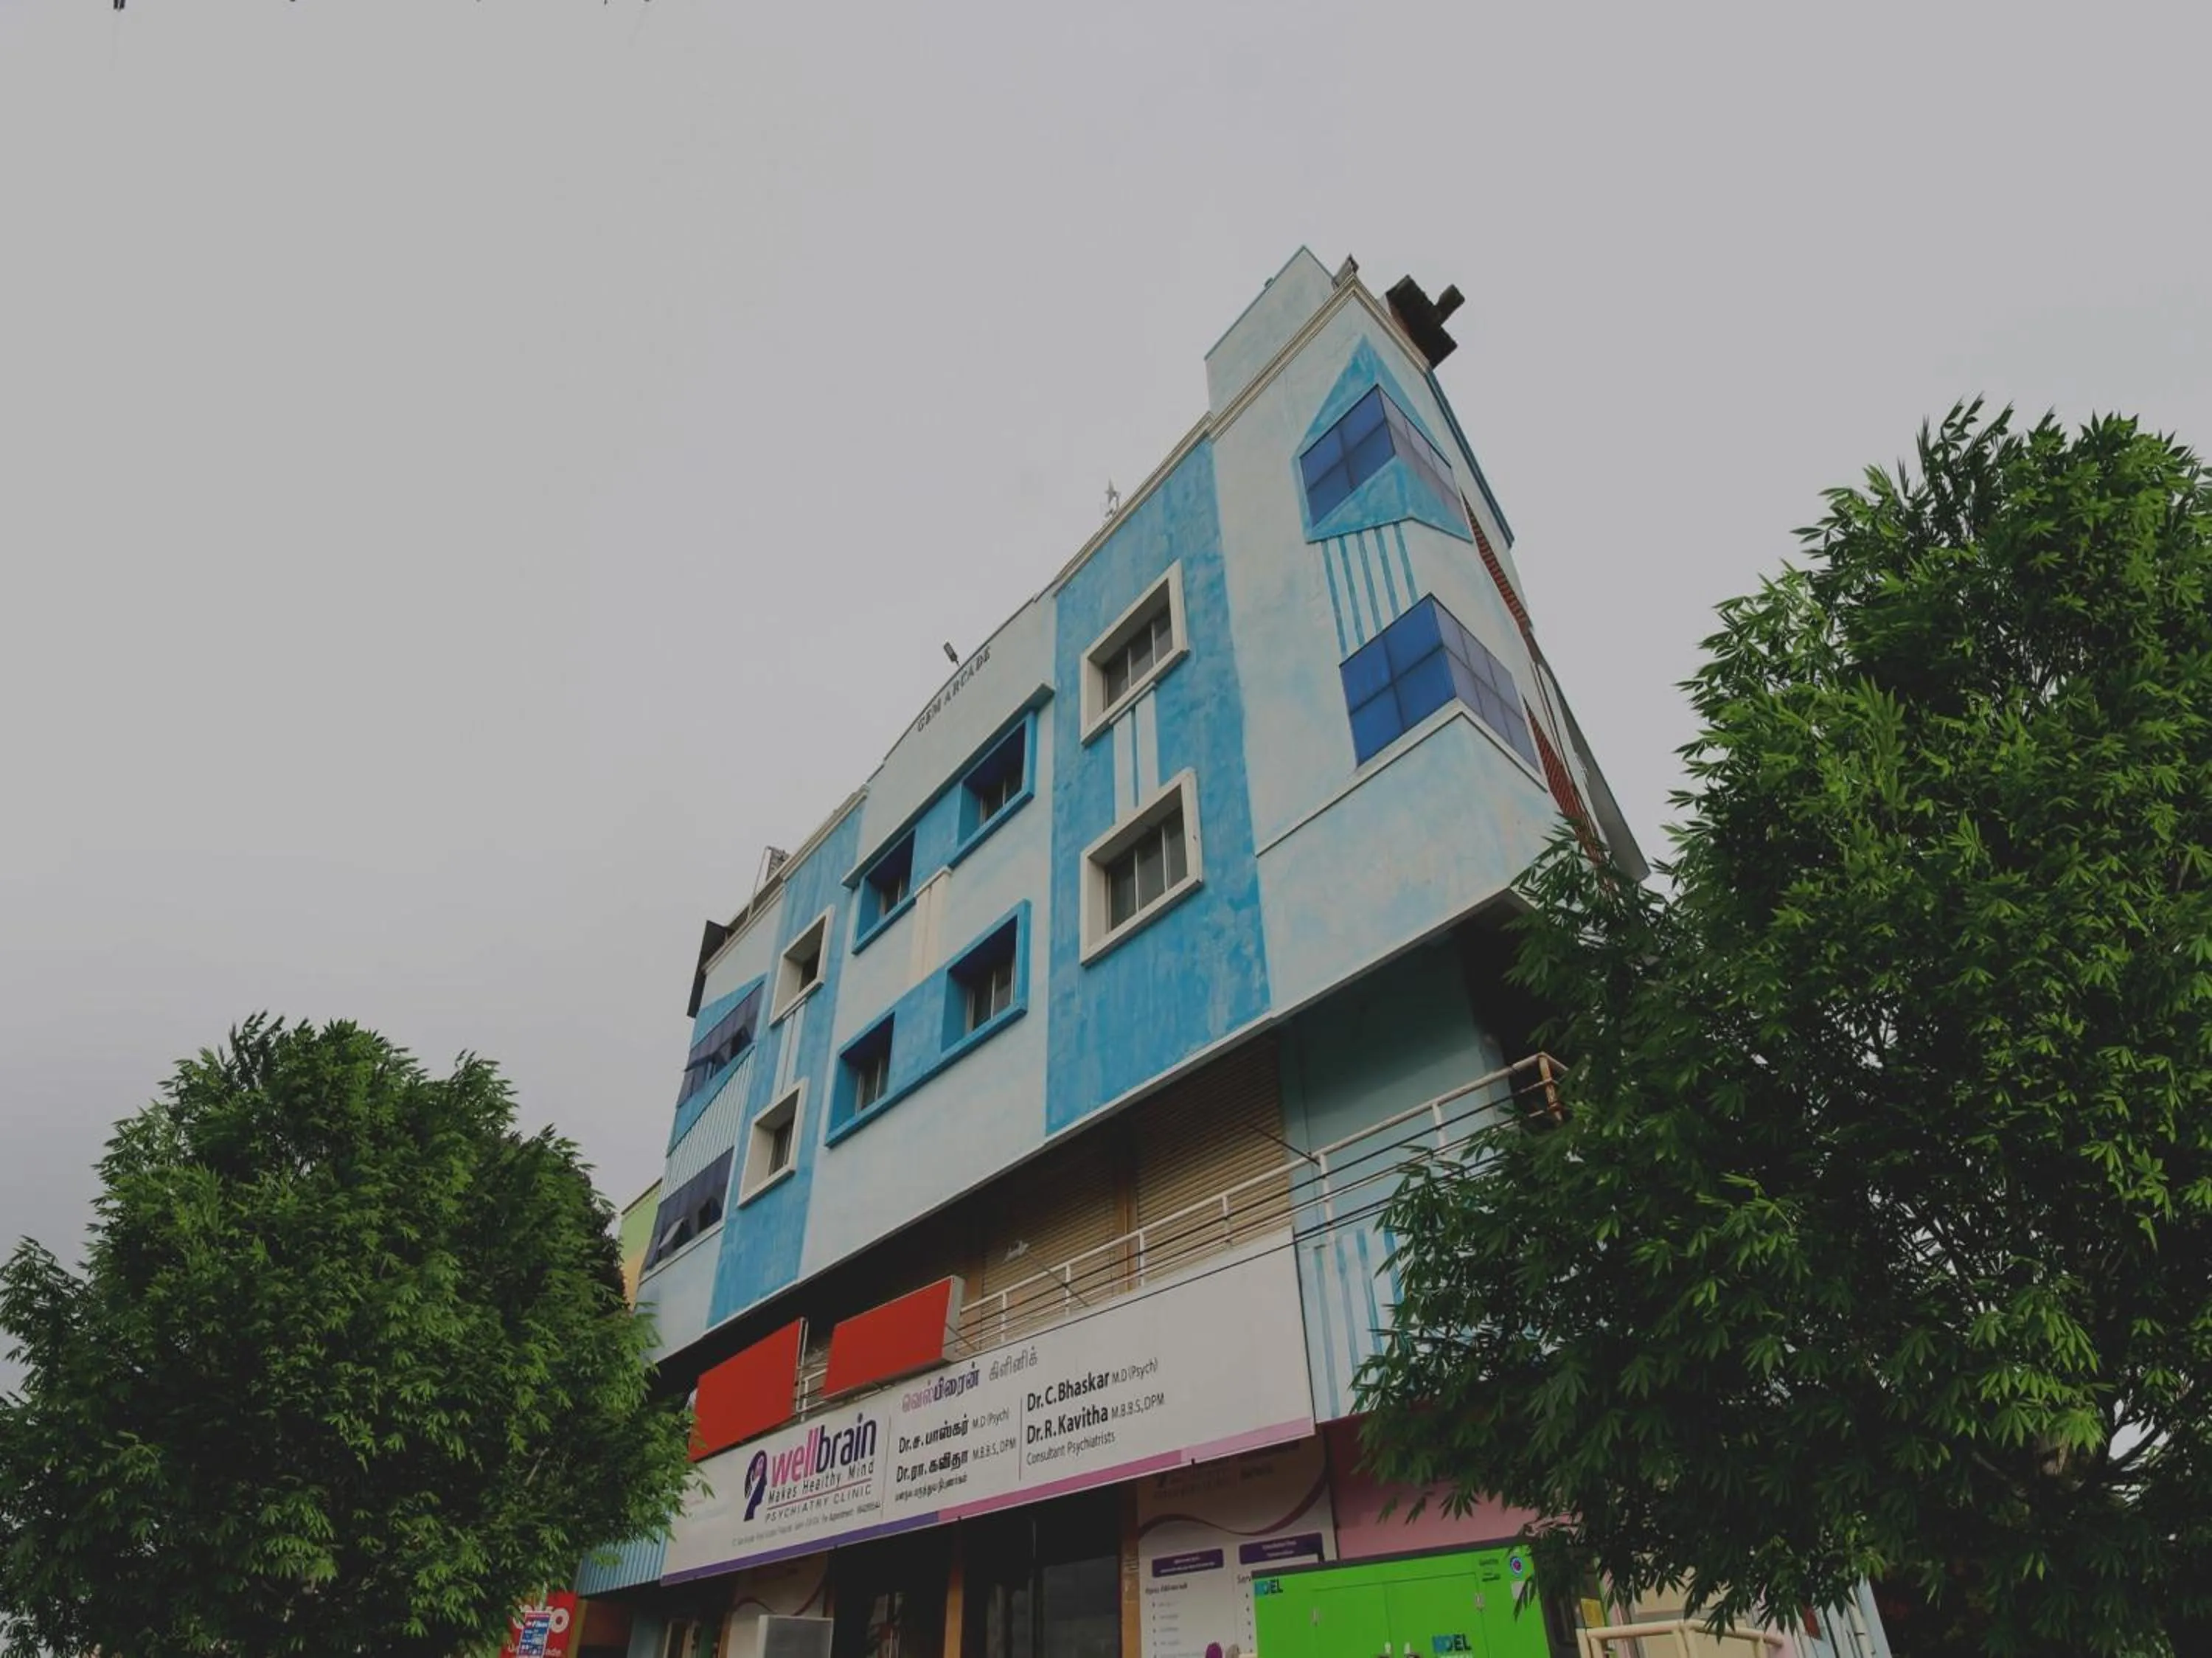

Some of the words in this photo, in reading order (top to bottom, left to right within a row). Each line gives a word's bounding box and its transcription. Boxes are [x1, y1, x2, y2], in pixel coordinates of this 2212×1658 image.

[771, 1412, 877, 1488] wellbrain
[1026, 1445, 1065, 1466] Consultant
[1067, 1431, 1116, 1456] Psychiatrists
[768, 1486, 797, 1505] Makes
[802, 1473, 841, 1494] Healthy
[847, 1459, 874, 1479] Mind
[765, 1497, 829, 1523] PSYCHIATRY
[833, 1485, 872, 1505] CLINIC
